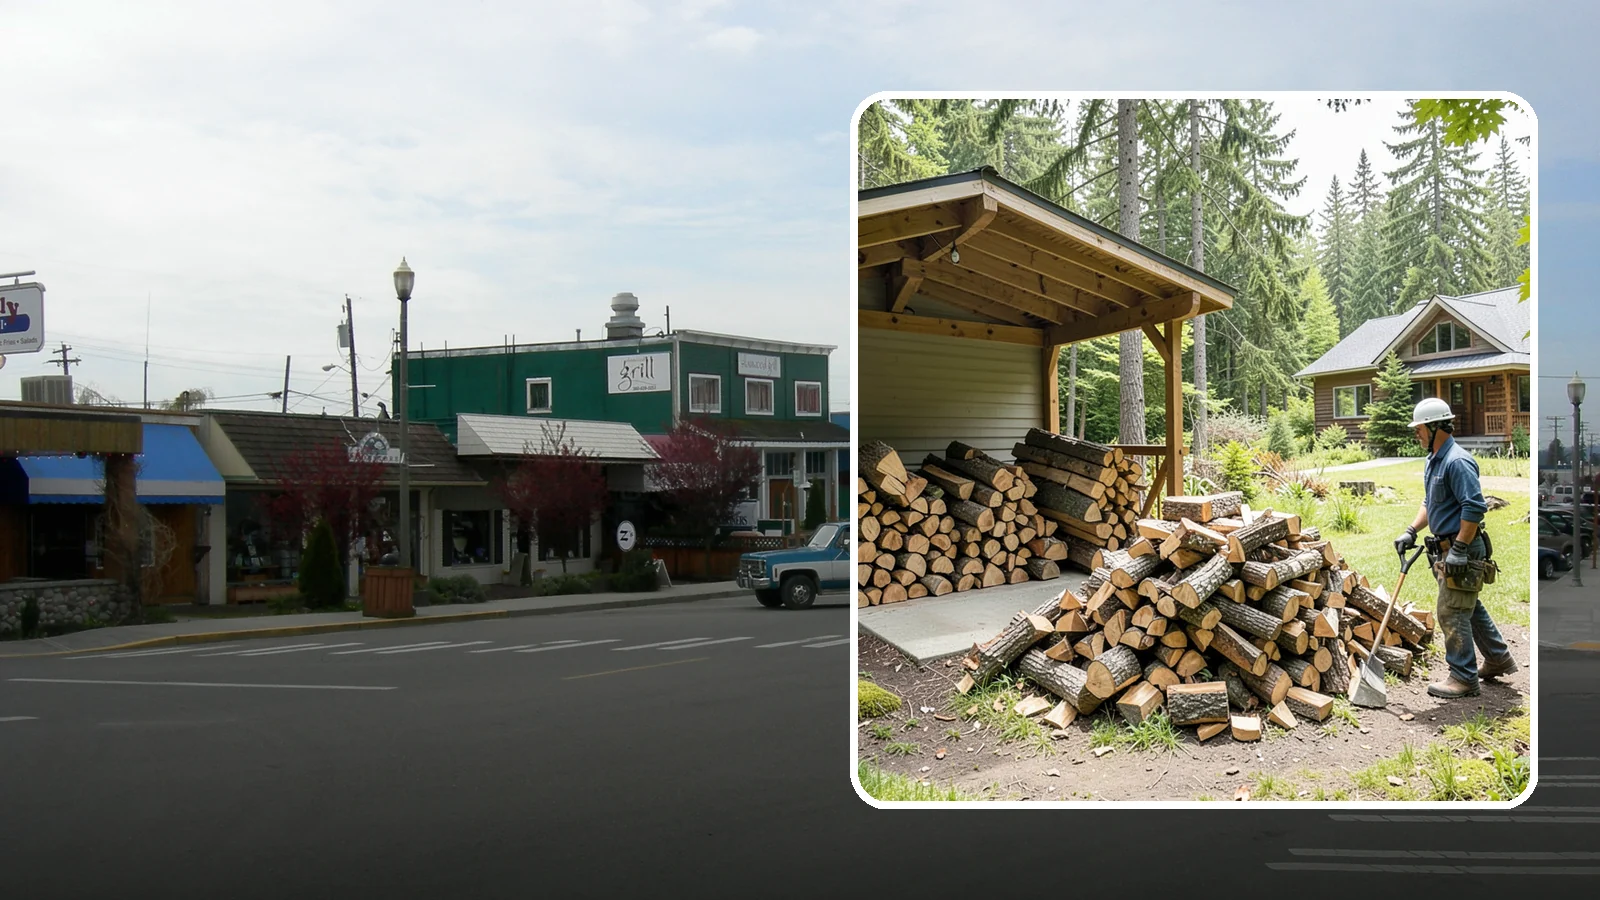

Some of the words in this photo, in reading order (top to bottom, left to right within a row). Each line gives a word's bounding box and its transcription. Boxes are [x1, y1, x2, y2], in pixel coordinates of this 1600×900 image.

[4, 338, 16, 346] Fries
[20, 337, 38, 345] Salads
[617, 356, 654, 391] grill
